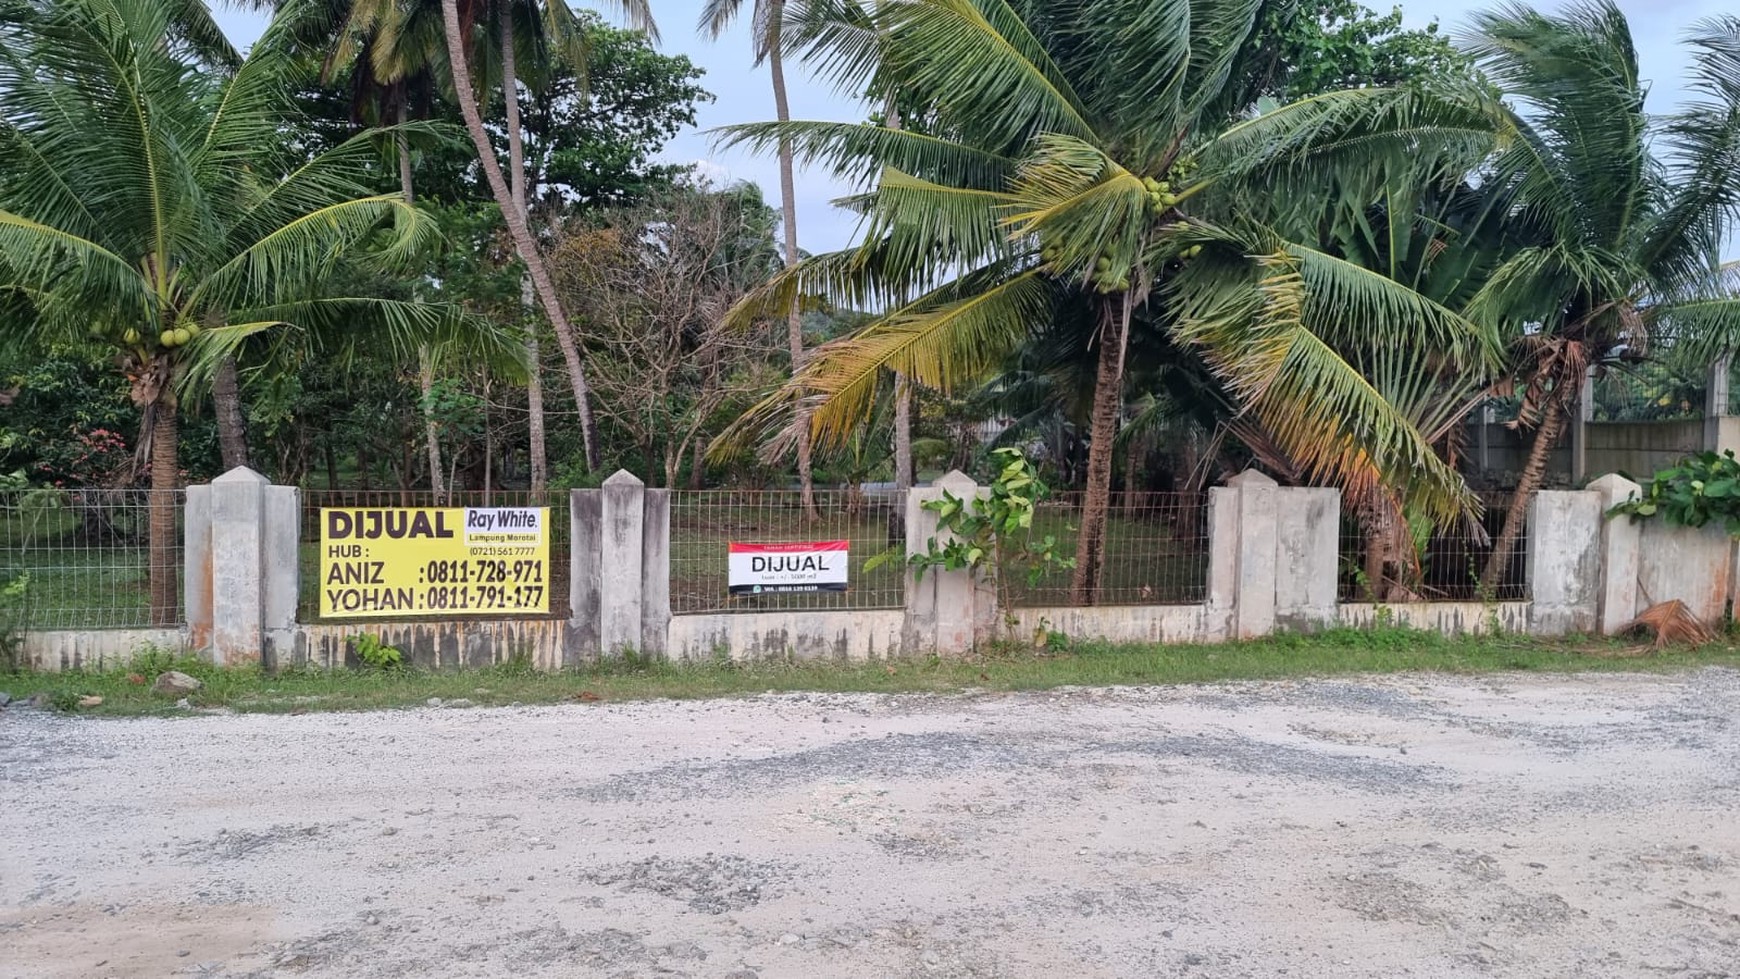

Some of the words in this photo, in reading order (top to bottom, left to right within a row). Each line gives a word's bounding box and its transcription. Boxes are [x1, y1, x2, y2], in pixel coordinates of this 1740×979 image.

[328, 510, 454, 539] DIJUAL
[468, 510, 495, 531] Ray
[469, 534, 505, 542] Lampung
[328, 545, 362, 558] HUB
[470, 547, 496, 556] (0721)
[498, 548, 513, 556] 561
[515, 547, 535, 556] 7777
[326, 561, 385, 585] ANIZ
[751, 555, 830, 572] DIJUAL
[326, 588, 414, 611] YOHAN
